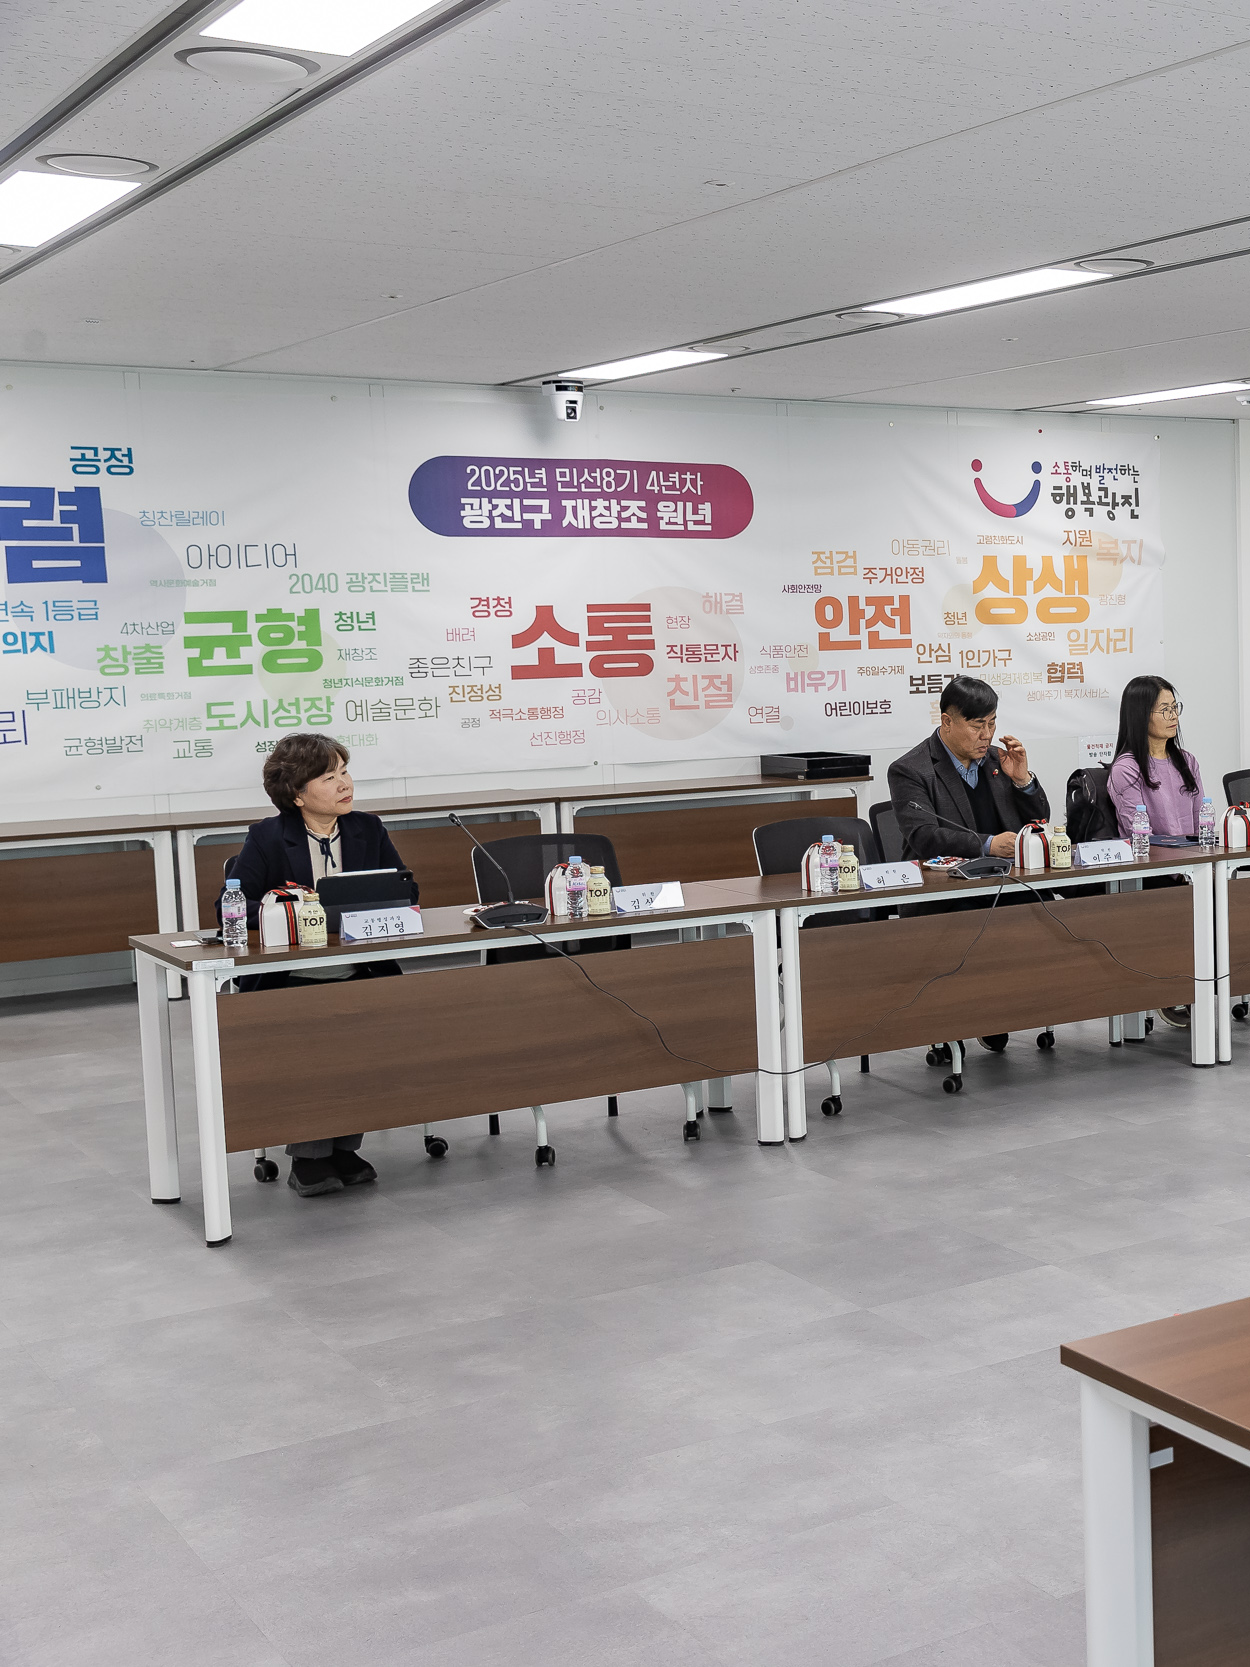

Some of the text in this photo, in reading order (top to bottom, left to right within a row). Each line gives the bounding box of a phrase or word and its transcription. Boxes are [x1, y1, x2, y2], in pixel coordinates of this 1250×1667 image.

[69, 446, 135, 476] 공정
[466, 465, 704, 496] 2025년 민선8기 4년차
[1050, 460, 1140, 485] 소통하며 발전하는
[1050, 481, 1140, 521] 행복광진
[138, 509, 226, 528] 칭찬릴레이
[460, 497, 713, 532] 광진구 재창조 원년
[0, 485, 108, 584] 렴
[976, 534, 1024, 546] 고령친화도시
[1061, 529, 1093, 548] 지원
[186, 542, 298, 570] 아이디어
[891, 538, 951, 557] 아동권리
[1096, 537, 1144, 567] 복지
[811, 550, 858, 577] 점검
[288, 571, 431, 595] 2040 광진플랜
[862, 566, 925, 585] 주거안정
[781, 584, 823, 594] 사회안전망
[972, 554, 1091, 625] 상생
[1098, 593, 1127, 606] 광진형
[42, 599, 100, 623] 1등급
[469, 596, 514, 619] 경청
[701, 592, 745, 616] 해결
[120, 620, 176, 637] 4차산업
[334, 611, 377, 633] 청년
[665, 614, 691, 631] 현장
[814, 594, 914, 652] 안전
[943, 611, 968, 626] 청년
[2, 630, 56, 655] 의지
[183, 608, 324, 678] 균형
[445, 627, 476, 643] 배려
[510, 602, 656, 681] 소통
[1026, 631, 1056, 642] 소상공인
[1066, 627, 1134, 656] 일자리
[96, 643, 166, 677] 창출
[336, 647, 378, 662] 재창조
[665, 643, 739, 664] 직통문자
[759, 644, 809, 659] 식품안전
[915, 642, 952, 664] 안심
[958, 648, 1013, 669] 1인가구
[407, 655, 494, 679] 좋은친구
[748, 664, 780, 675] 상호존중
[857, 665, 905, 677] 주6일수거제
[1046, 661, 1085, 684] 협력
[322, 675, 405, 690] 청년지식문화거점
[785, 669, 847, 694] 비우기
[25, 685, 128, 712] 부패방지
[448, 683, 503, 704] 진정성
[571, 687, 603, 706] 공감
[666, 673, 735, 712] 친절
[1027, 688, 1110, 702] 생애주기 복지서비스
[205, 695, 335, 732] 도시성장
[345, 696, 442, 723] 예술문화
[488, 706, 565, 722] 적극소통행정
[595, 707, 662, 727] 의사소통
[747, 705, 781, 725] 연결
[824, 699, 893, 718] 어린이보호
[142, 717, 203, 733] 취약계층
[460, 717, 481, 729] 공정
[63, 734, 145, 757] 균형발전
[172, 738, 215, 759] 교통
[529, 729, 586, 748] 선진행정
[588, 888, 608, 898] T.O.P
[302, 916, 325, 928] T.O.P
